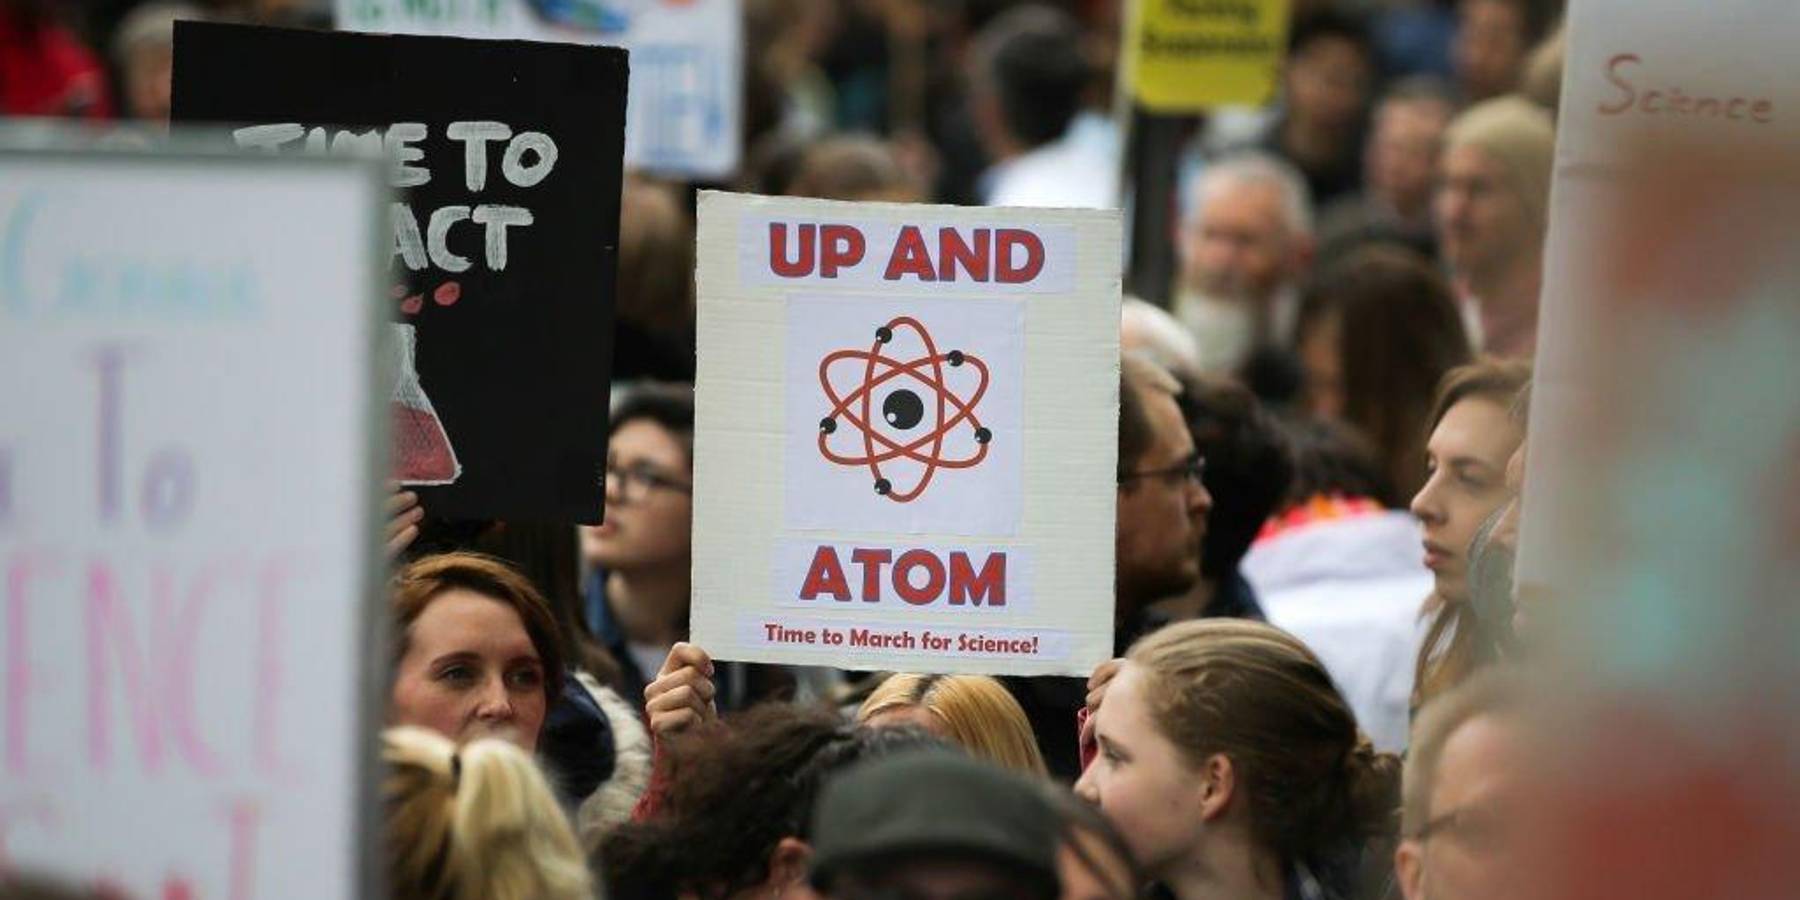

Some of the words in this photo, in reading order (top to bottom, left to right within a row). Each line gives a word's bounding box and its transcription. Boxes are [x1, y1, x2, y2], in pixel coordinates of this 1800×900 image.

[1597, 53, 1773, 123] Science
[446, 121, 559, 192] TO
[389, 203, 534, 273] ACT
[769, 222, 866, 279] UP
[883, 225, 1046, 284] AND
[799, 545, 1008, 606] ATOM
[765, 624, 816, 644] Time
[822, 628, 844, 646] to
[850, 629, 916, 649] March
[921, 631, 952, 651] for
[958, 634, 1039, 654] Science!
